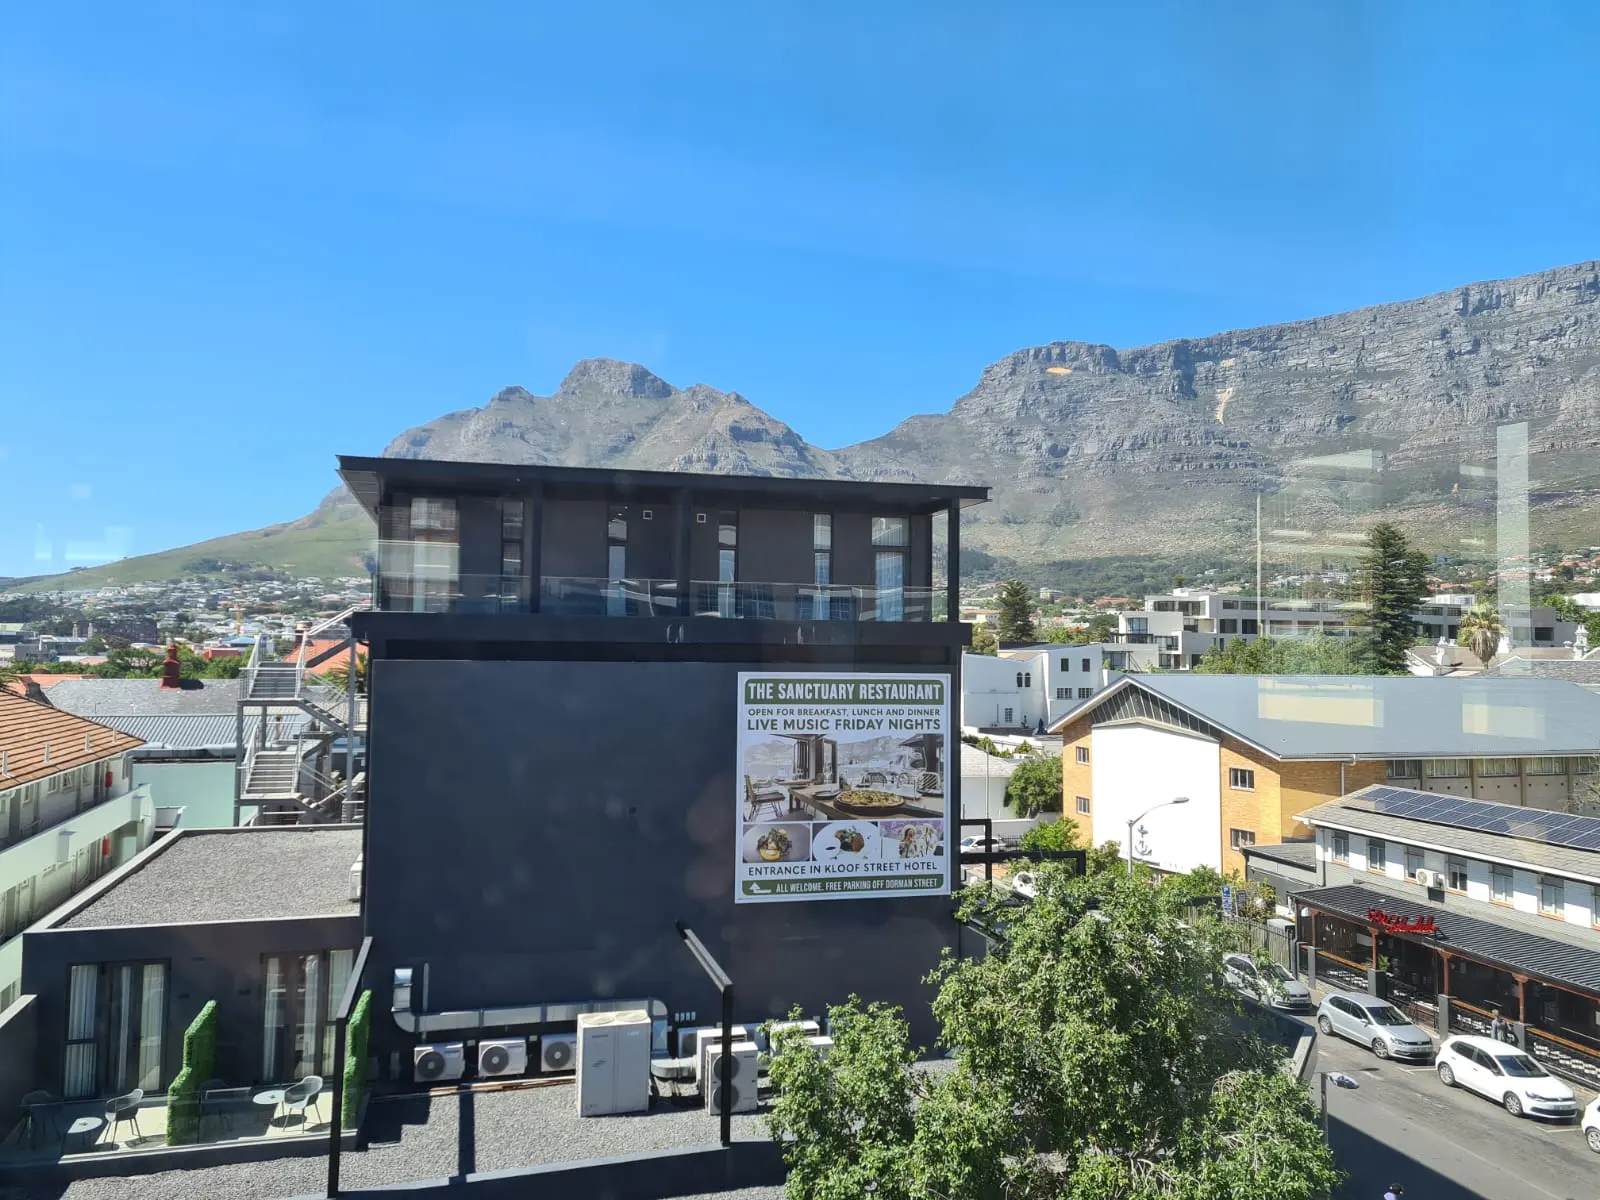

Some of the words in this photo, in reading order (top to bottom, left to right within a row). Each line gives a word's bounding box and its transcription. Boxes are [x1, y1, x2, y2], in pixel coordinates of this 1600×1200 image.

[748, 683, 774, 699] THE
[778, 683, 855, 699] SANCTUARY
[860, 683, 941, 699] RESTAURANT
[748, 708, 773, 716] OPEN
[776, 708, 794, 716] FOR
[798, 708, 849, 717] BREAKFAST,
[852, 708, 882, 716] LUNCH
[886, 708, 905, 716] AND
[907, 708, 940, 716] DINNER
[747, 719, 778, 730] LIVE
[783, 719, 830, 730] MUSIC
[835, 719, 884, 730] FRIDAY
[888, 719, 941, 730] NIGHTS
[748, 865, 806, 876] ENTRANCE
[810, 865, 821, 874] IN
[824, 863, 860, 873] KLOOF
[864, 862, 900, 872] STREET
[904, 861, 937, 871] HOTEL
[776, 883, 788, 893] ALL
[825, 881, 842, 891] FREE
[843, 880, 870, 890] PARKING
[872, 879, 884, 889] OFF
[885, 879, 912, 888] DORMAN
[912, 878, 937, 888] STREET
